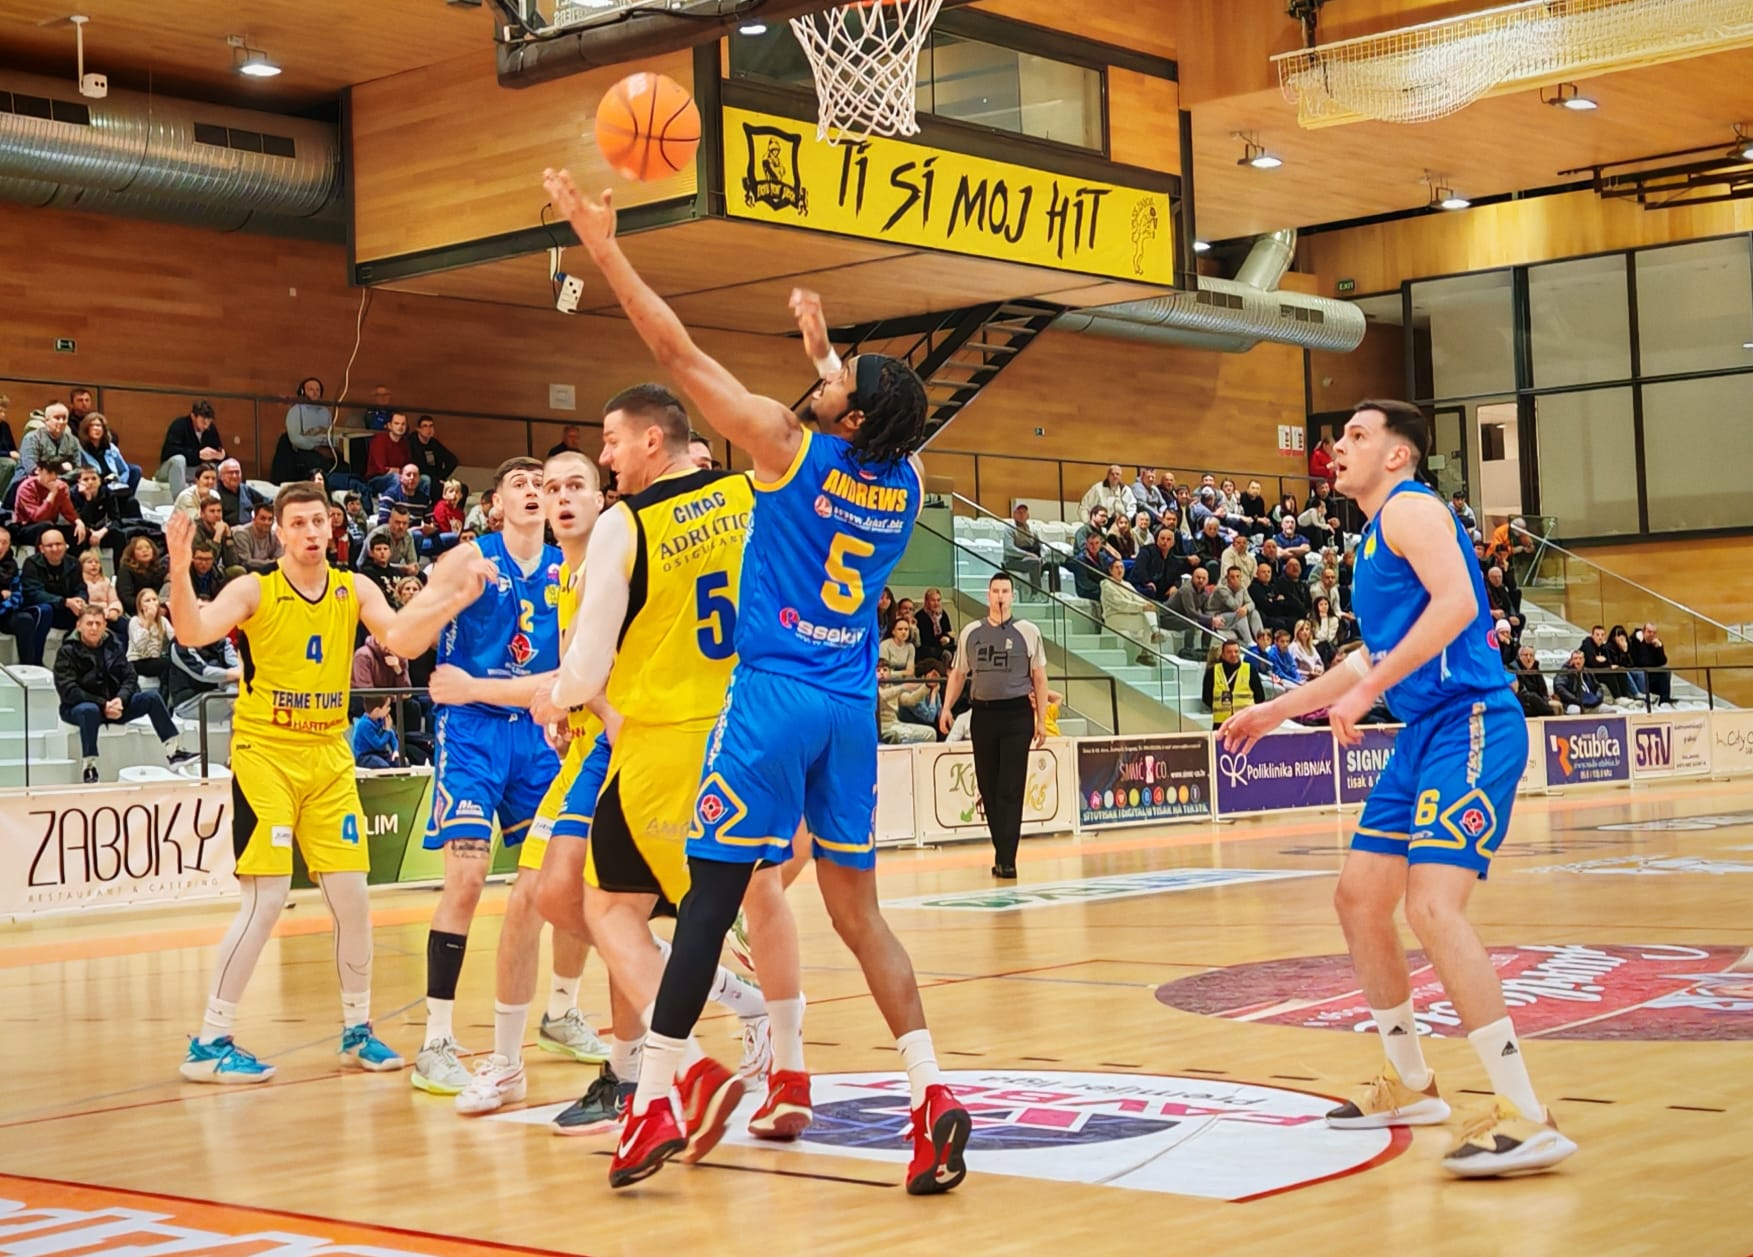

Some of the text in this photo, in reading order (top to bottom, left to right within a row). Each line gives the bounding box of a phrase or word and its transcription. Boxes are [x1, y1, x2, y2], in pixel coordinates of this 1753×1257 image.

[946, 174, 1033, 244] MOJ
[822, 468, 909, 513] ANDREWS
[819, 531, 876, 616] 5
[519, 598, 535, 634] 2
[696, 570, 738, 661] 5
[305, 635, 323, 664] 4
[272, 690, 311, 709] TERME
[1346, 749, 1395, 772] SIGNA
[1571, 733, 1620, 760] Stubica
[1247, 760, 1333, 780] Poliklinika RIBNJAK
[1347, 776, 1367, 789] tisak
[1415, 788, 1441, 826] 6
[342, 813, 359, 844] 4
[28, 886, 123, 903] RESTAURANT
[149, 877, 219, 892] CATERING
